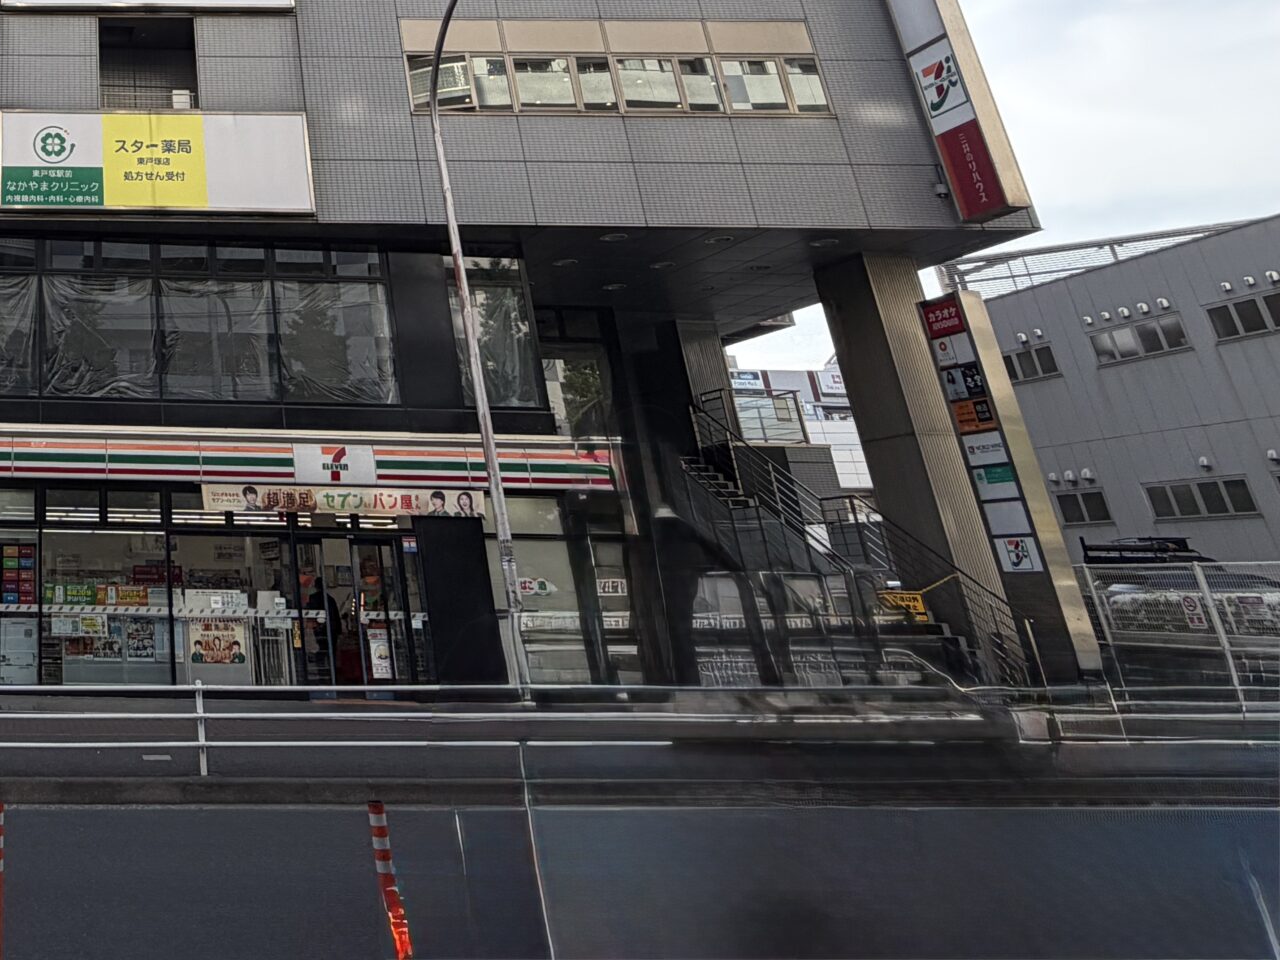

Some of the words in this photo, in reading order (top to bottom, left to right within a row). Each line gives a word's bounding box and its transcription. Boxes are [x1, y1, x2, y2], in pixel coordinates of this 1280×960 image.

[114, 140, 192, 154] スター薬局
[137, 157, 170, 166] 東戸塚店
[32, 169, 72, 178] 東戸塚駅前
[958, 133, 988, 203] 三井のリハウス
[123, 171, 185, 182] 処方せん受付
[6, 181, 99, 192] なかやまクリニック
[928, 307, 957, 322] カラオケ
[267, 489, 310, 508] 超満足
